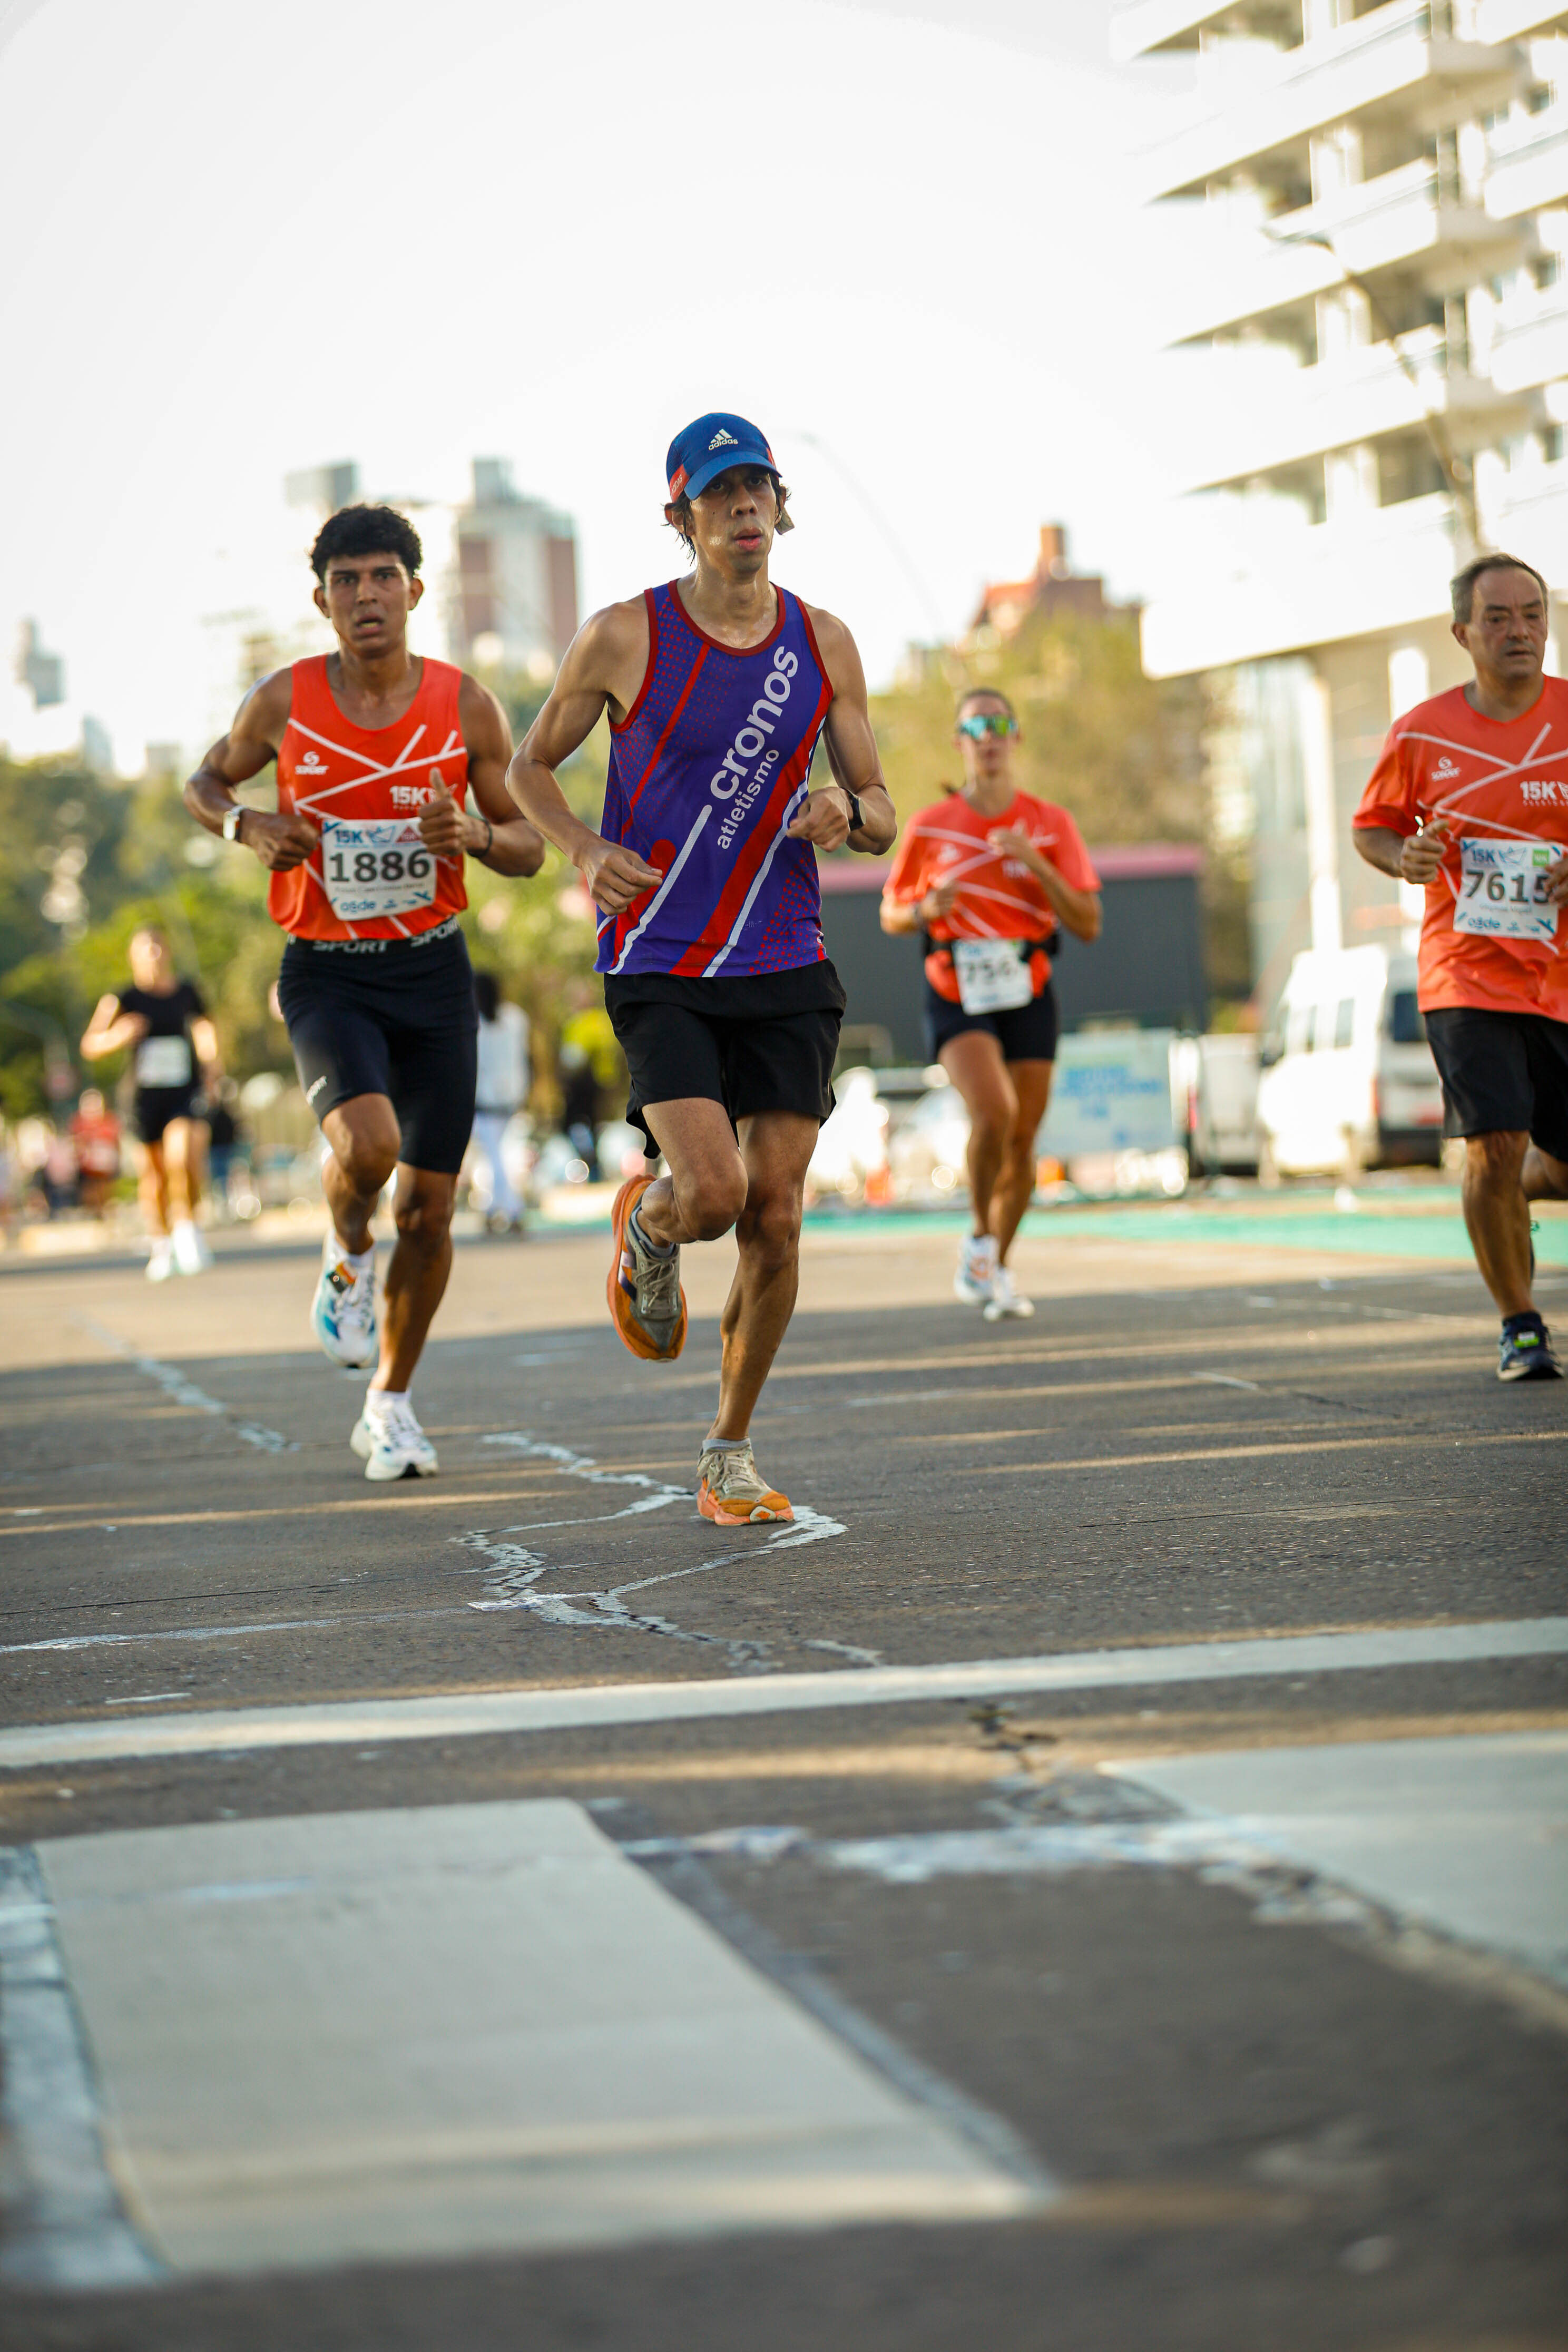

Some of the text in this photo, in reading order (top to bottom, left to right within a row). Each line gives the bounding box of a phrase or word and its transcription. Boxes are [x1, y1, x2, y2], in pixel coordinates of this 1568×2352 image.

[708, 438, 738, 450] adidas
[671, 474, 682, 495] ADIDAS
[710, 646, 798, 799] cronos
[389, 786, 425, 806] 15K
[717, 750, 779, 849] atletismo
[1520, 781, 1557, 800] 15K
[336, 829, 362, 843] 15K
[330, 848, 430, 882] 1886
[1472, 847, 1496, 863] 15K
[1465, 869, 1551, 904] 7615
[312, 940, 388, 954] SPORT
